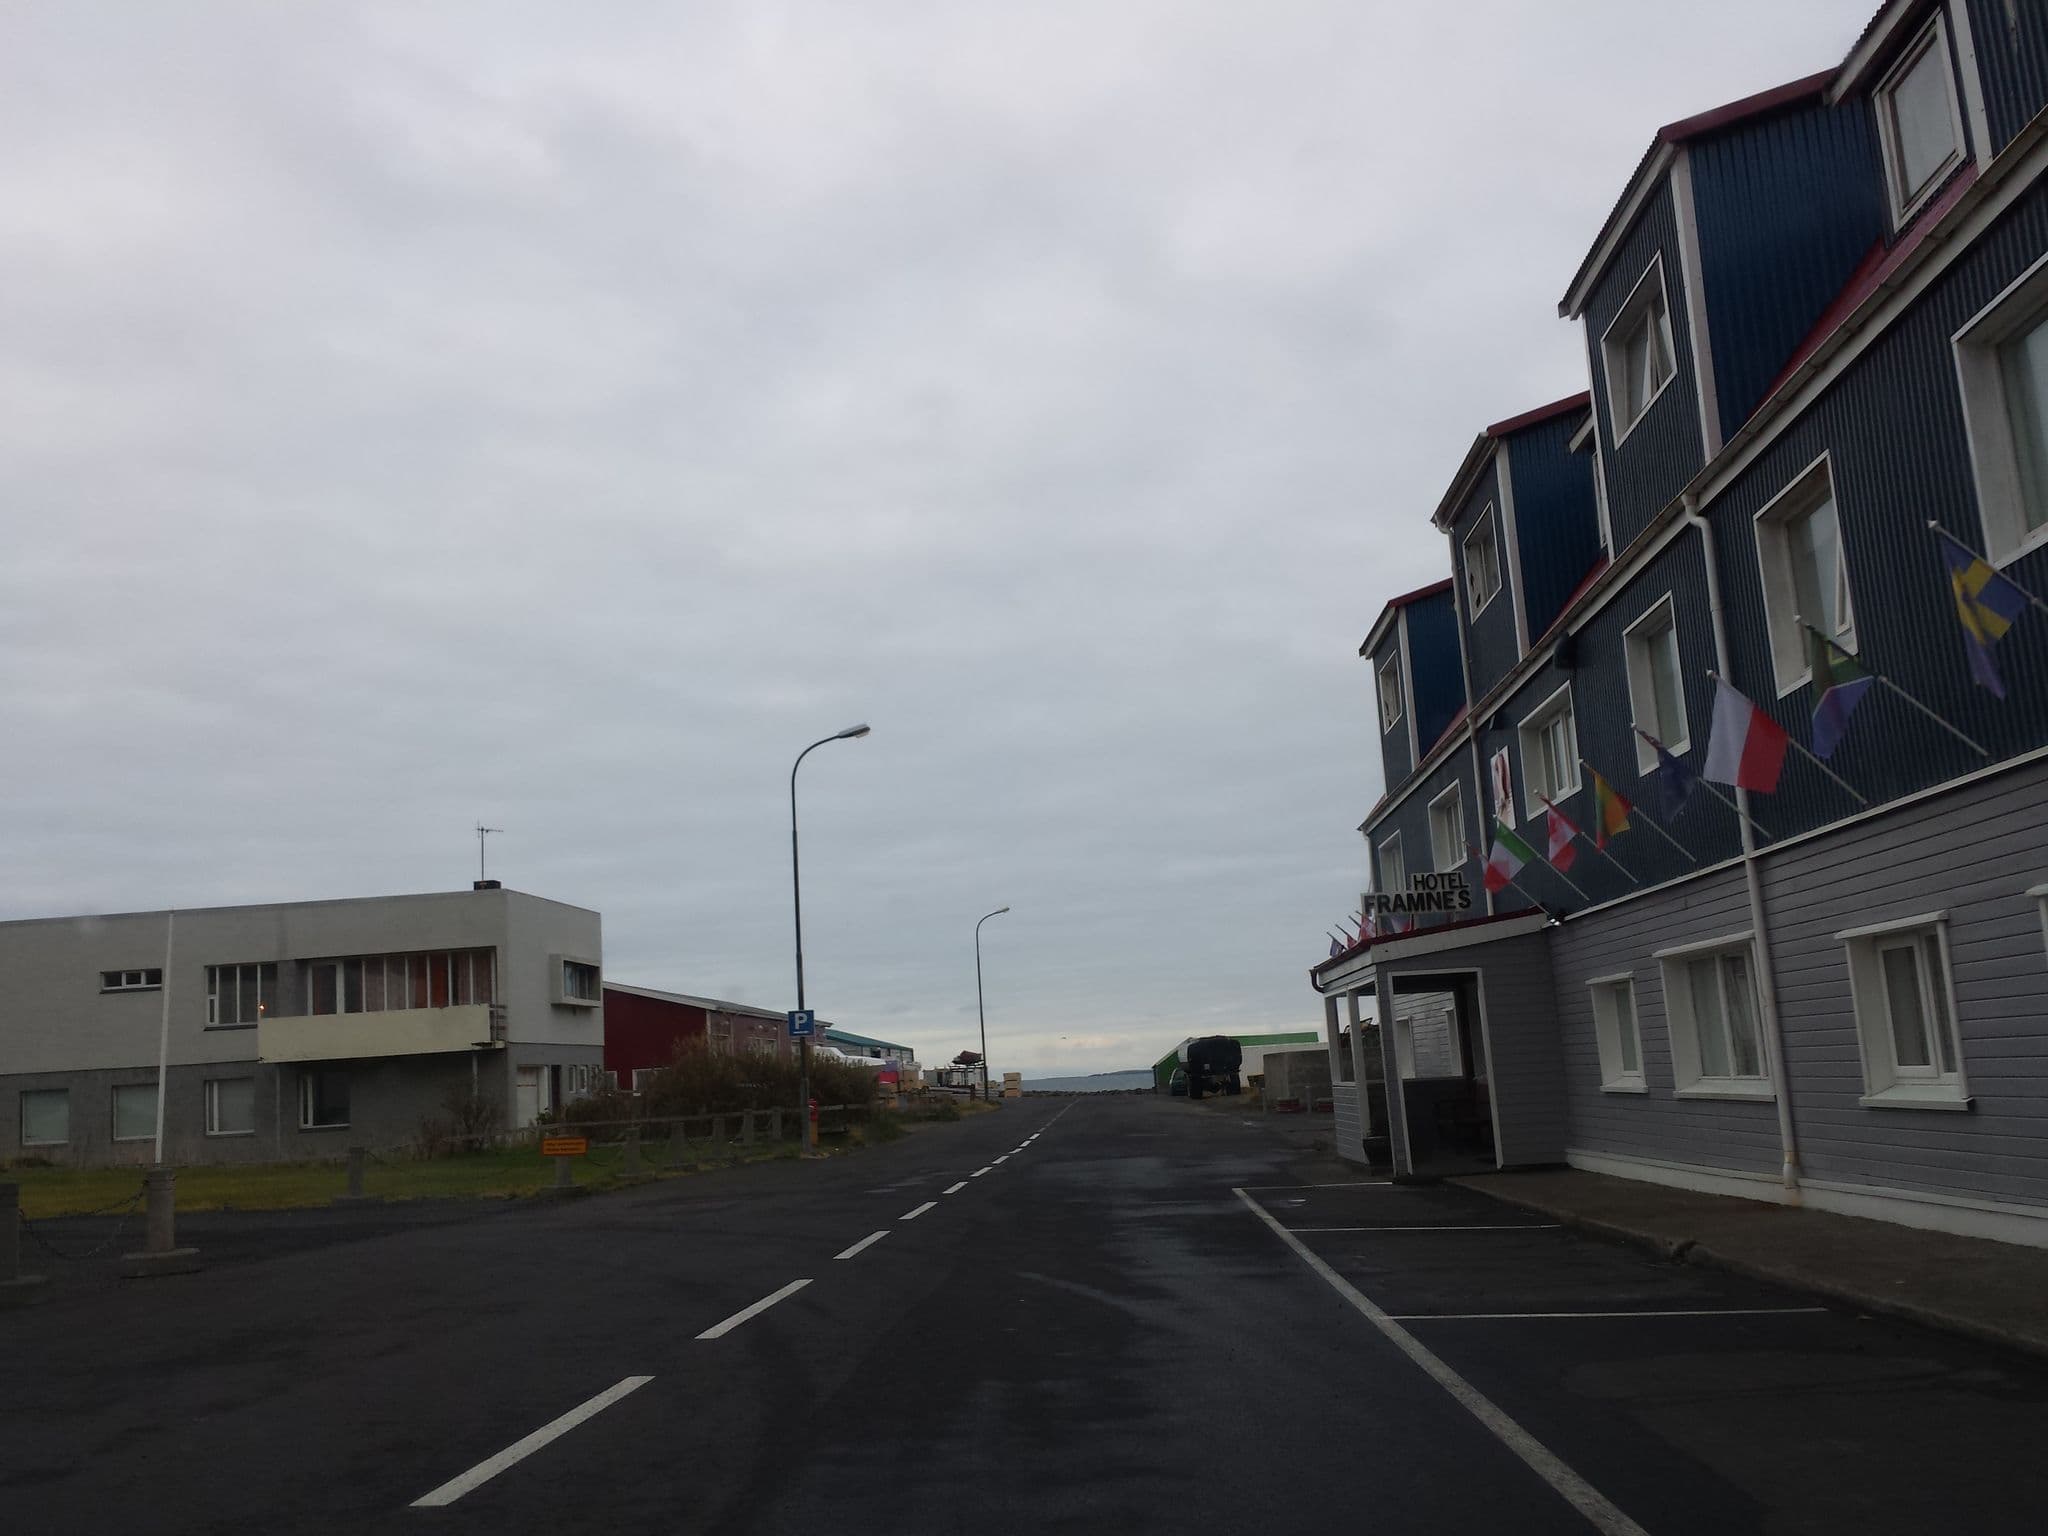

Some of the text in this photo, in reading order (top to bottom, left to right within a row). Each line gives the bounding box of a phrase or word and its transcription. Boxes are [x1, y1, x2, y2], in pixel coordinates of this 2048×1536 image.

[1413, 872, 1469, 891] HOTEL
[1364, 889, 1472, 914] FRAMNES
[794, 1013, 808, 1030] P
